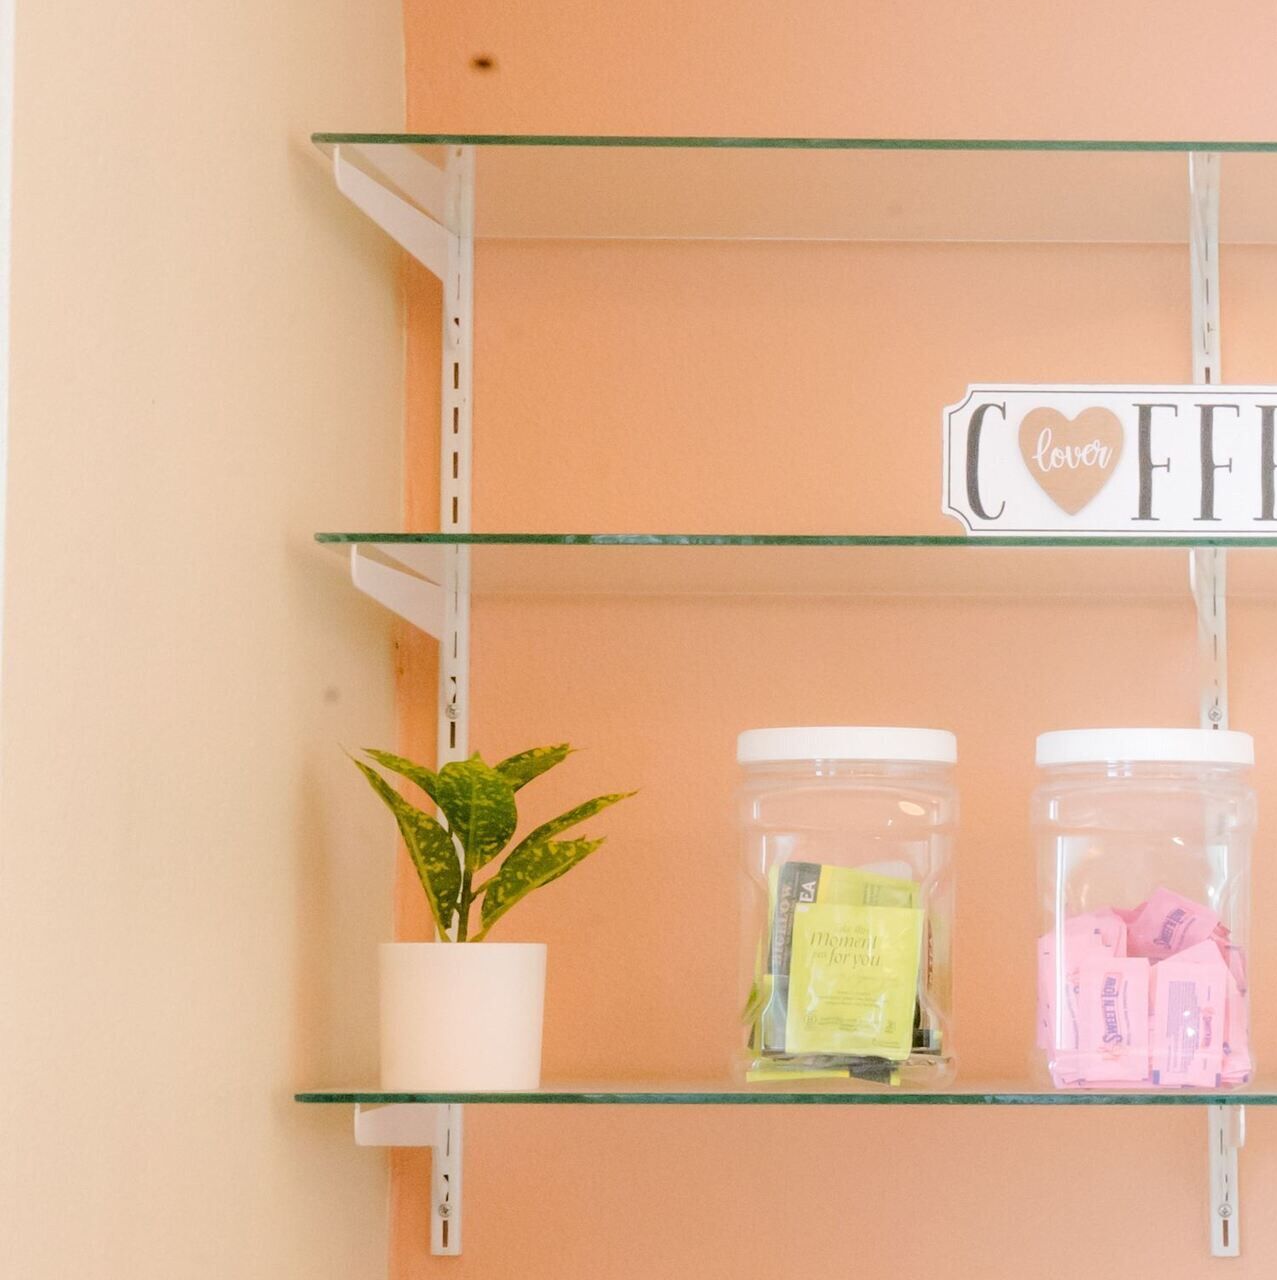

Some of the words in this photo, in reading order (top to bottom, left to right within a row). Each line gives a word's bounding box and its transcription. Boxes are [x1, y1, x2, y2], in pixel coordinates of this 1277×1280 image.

[1031, 427, 1113, 473] lover
[799, 880, 817, 902] EA
[810, 931, 877, 950] Moment
[829, 947, 851, 967] for
[853, 953, 880, 969] you
